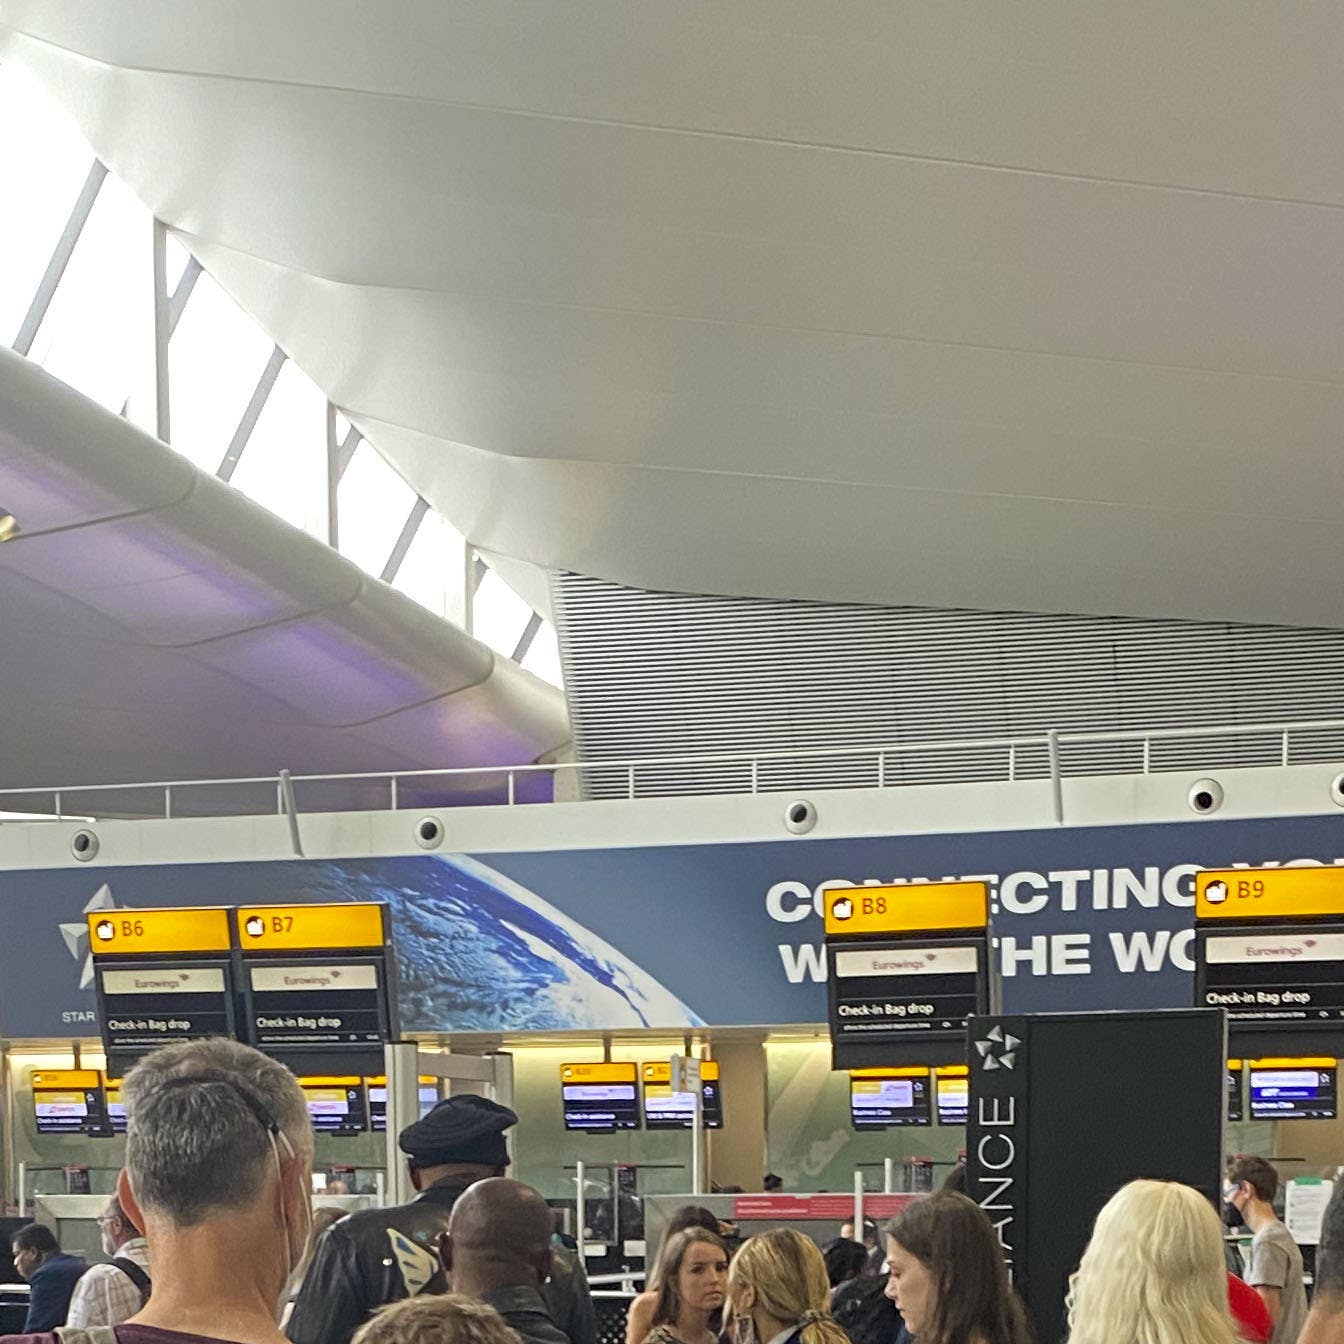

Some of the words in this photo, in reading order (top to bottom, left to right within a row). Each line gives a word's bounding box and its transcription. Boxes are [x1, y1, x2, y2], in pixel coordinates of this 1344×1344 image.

[1238, 880, 1265, 899] B9
[862, 897, 887, 915] B8
[121, 920, 144, 937] B6
[271, 917, 293, 933] B7
[992, 934, 1091, 976] HE
[1246, 946, 1304, 957] Eurowings
[873, 960, 925, 970] Eurowings
[134, 979, 180, 989] Eurowings
[284, 976, 331, 986] Eurowings
[1206, 991, 1256, 1004] Check-in
[1257, 992, 1280, 1005] Bag
[1281, 991, 1311, 1004] drop
[838, 1003, 884, 1016] Check-in
[885, 1004, 906, 1016] Bag
[907, 1003, 934, 1016] drop
[62, 1011, 96, 1023] STAR
[256, 1017, 296, 1029] Check-in
[297, 1017, 317, 1031] Bag
[318, 1016, 342, 1030] drop
[108, 1018, 147, 1030] Check-in
[148, 1019, 167, 1032] Bag
[168, 1018, 191, 1031] drop
